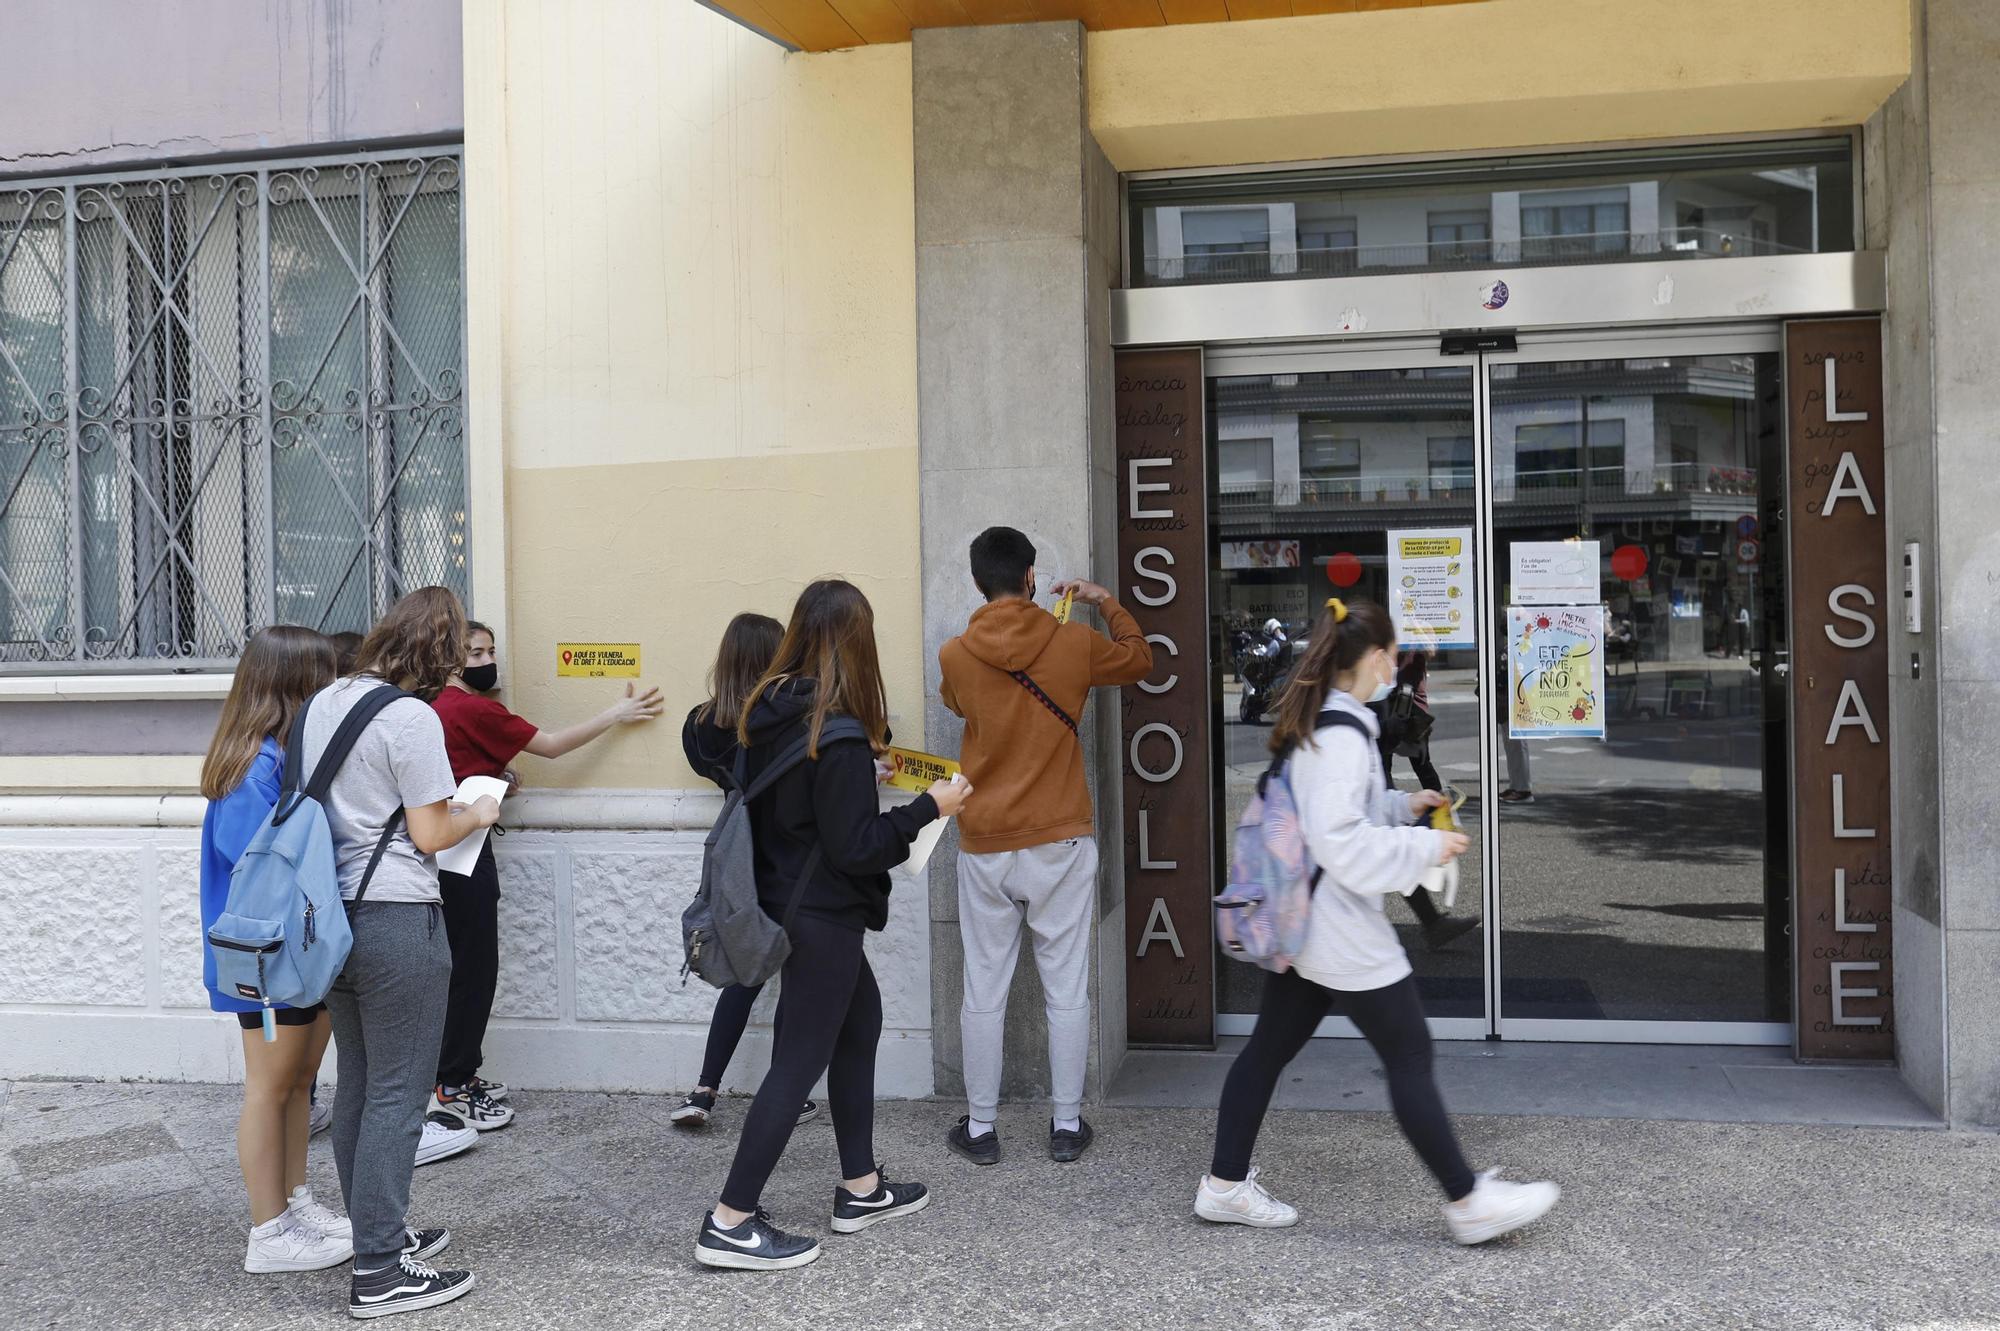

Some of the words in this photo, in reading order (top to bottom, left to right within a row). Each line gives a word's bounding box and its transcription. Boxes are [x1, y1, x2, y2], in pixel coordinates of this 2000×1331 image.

[1822, 357, 1877, 517] LA
[581, 658, 595, 666] DRET
[1539, 645, 1570, 659] ETS
[1540, 671, 1571, 690] NO
[1128, 457, 1184, 958] ESCOLA
[1825, 584, 1882, 1026] SALLE
